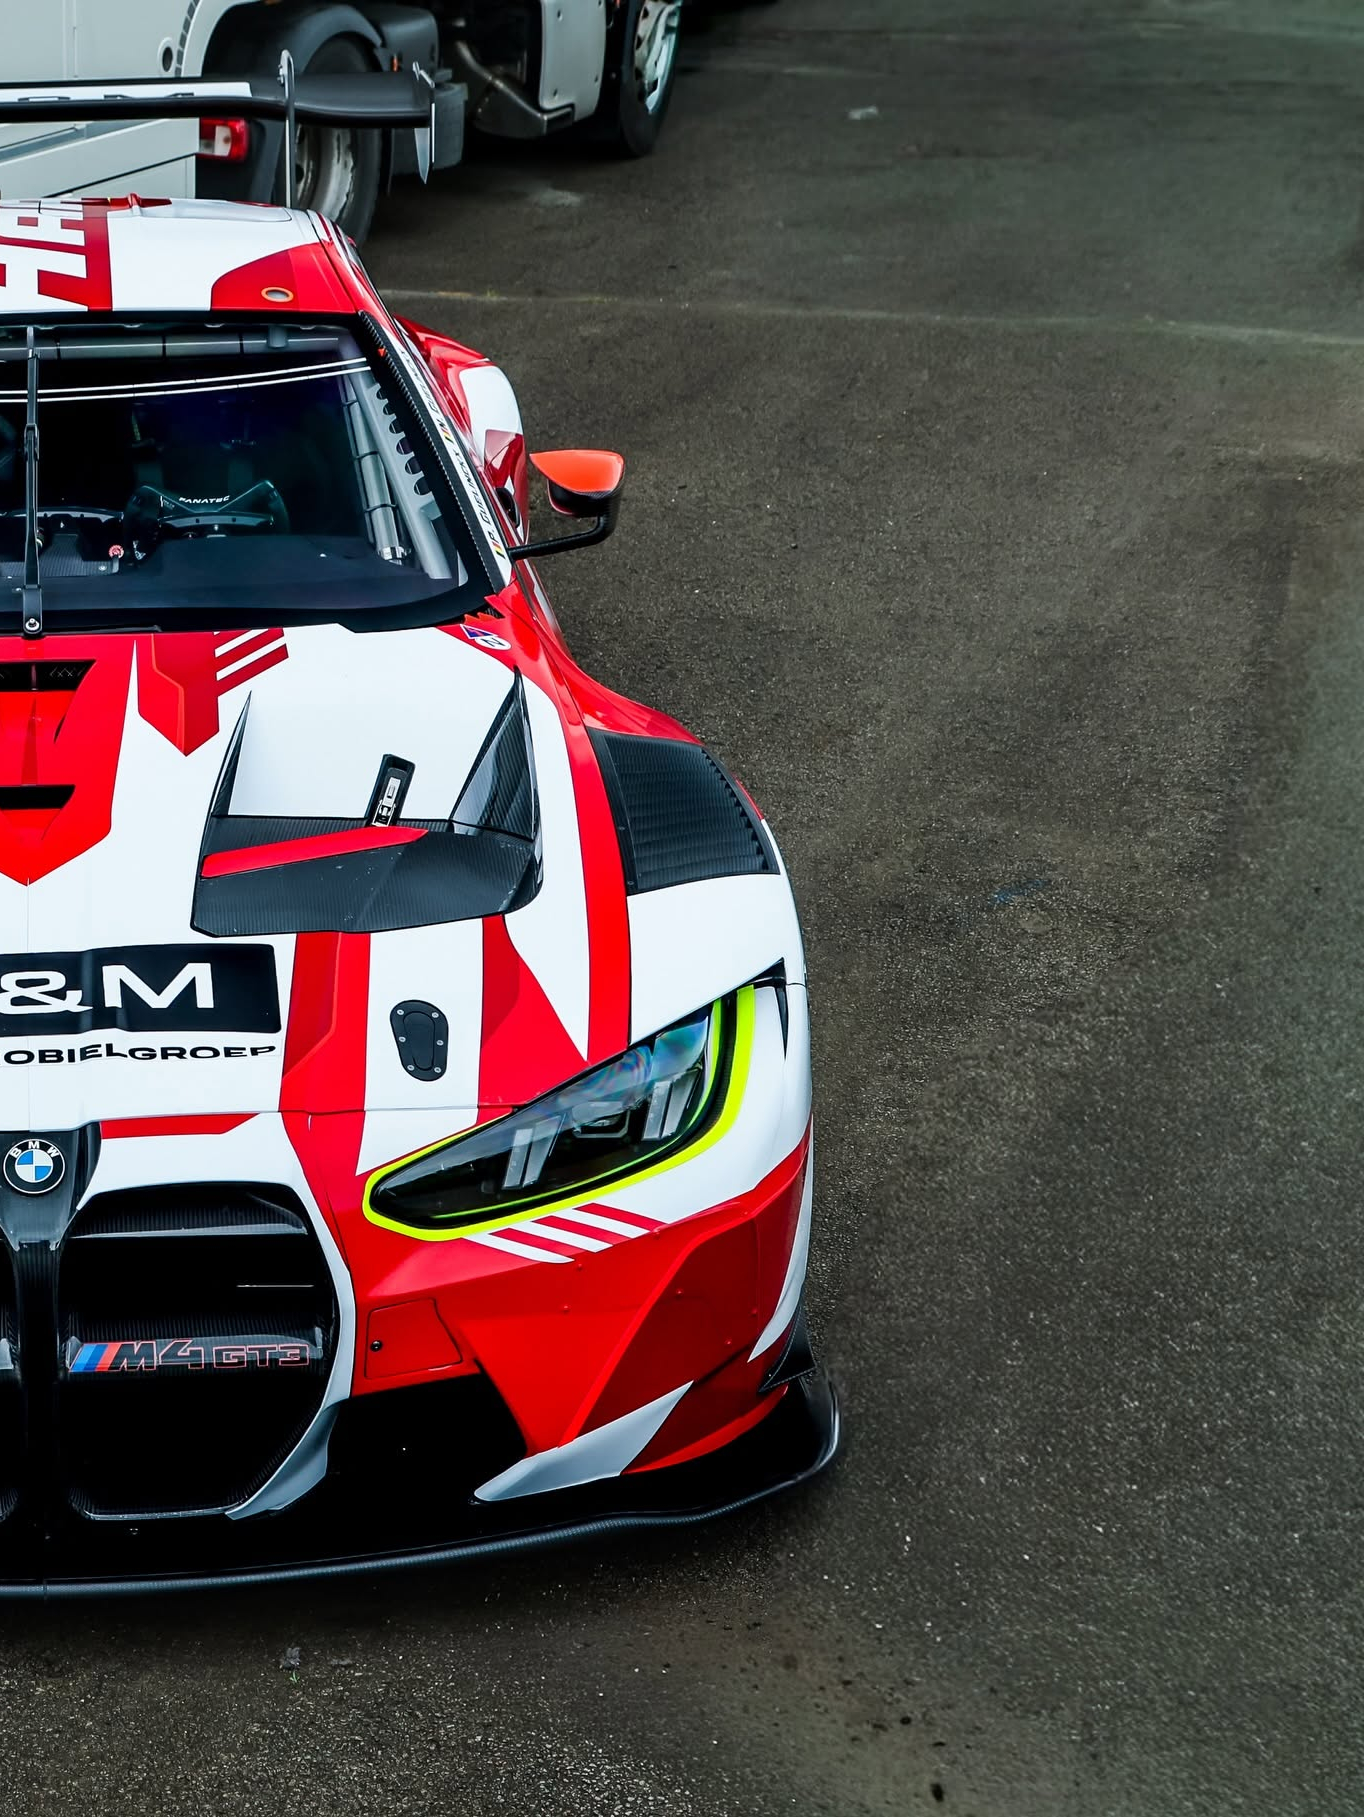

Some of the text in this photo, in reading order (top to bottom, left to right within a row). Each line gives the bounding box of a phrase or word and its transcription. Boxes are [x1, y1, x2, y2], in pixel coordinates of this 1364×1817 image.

[178, 495, 231, 504] FANATEC
[452, 449, 492, 525] GUELINCKX
[9, 1140, 60, 1159] BMW
[106, 1338, 310, 1371] M4 GT3
